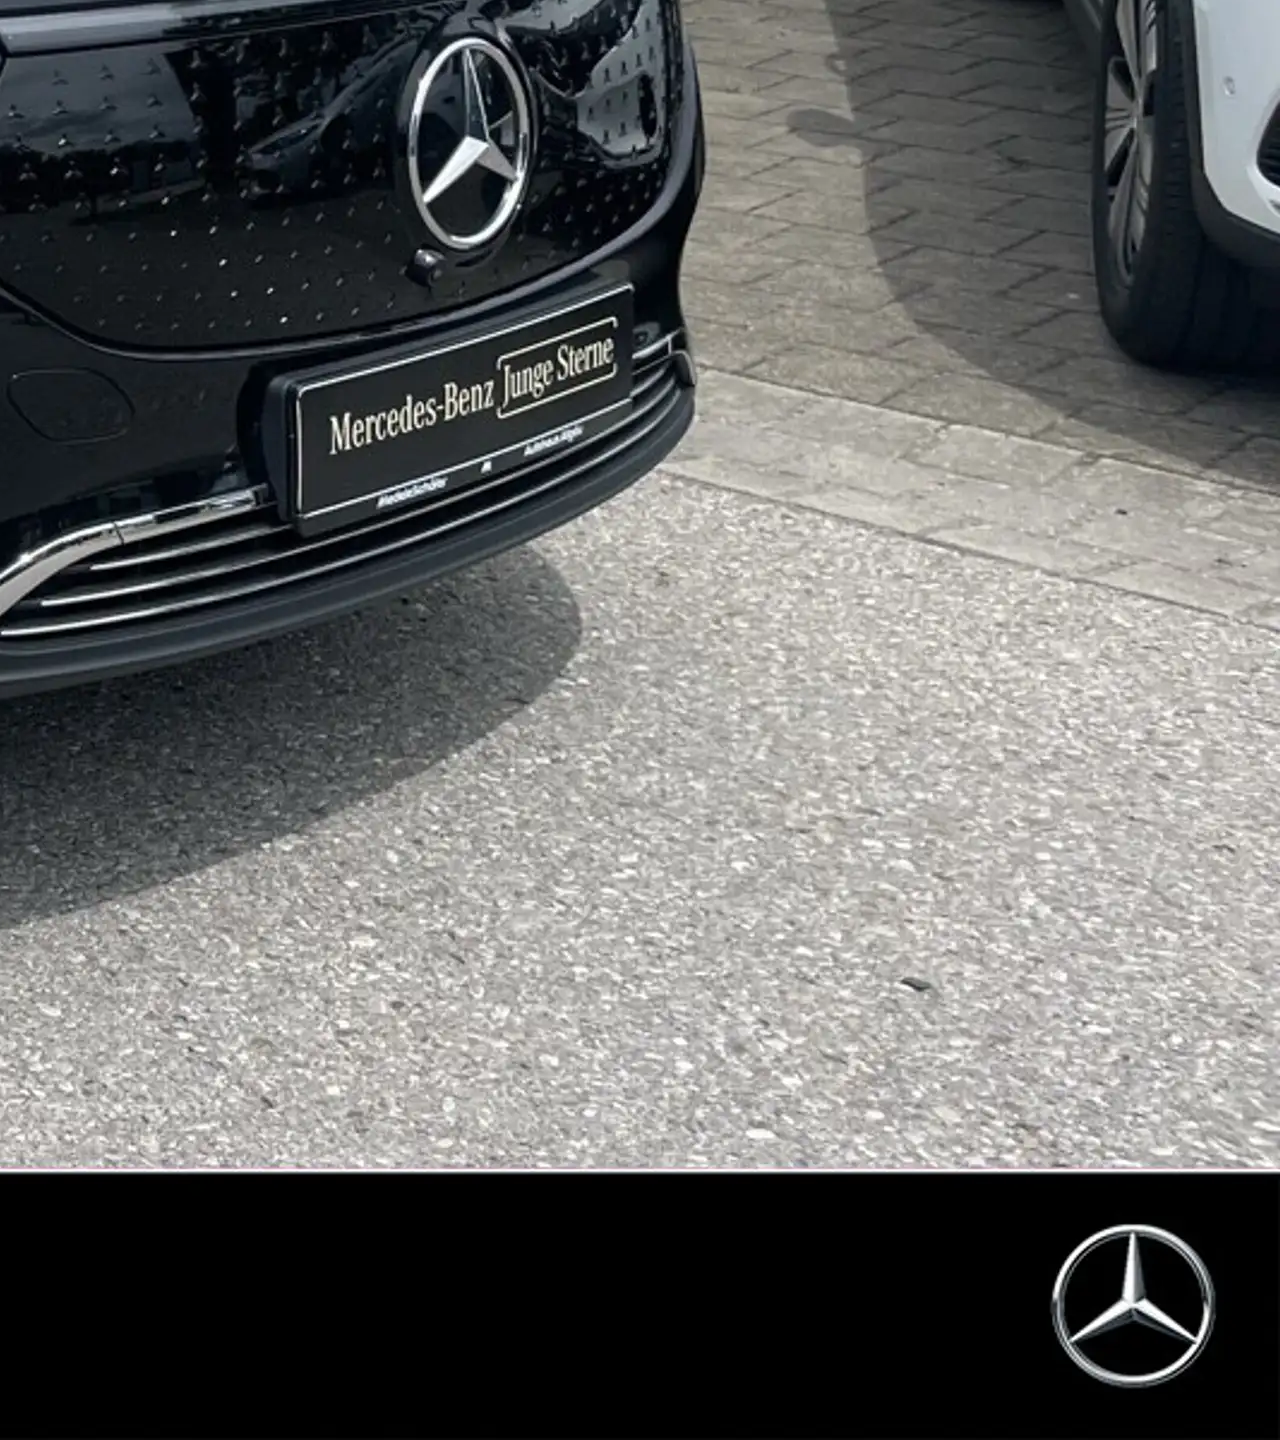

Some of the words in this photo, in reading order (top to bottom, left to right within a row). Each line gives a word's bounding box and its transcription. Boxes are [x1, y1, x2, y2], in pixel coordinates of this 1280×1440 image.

[329, 379, 495, 455] Mercedes-Benz
[502, 361, 554, 407] Junge
[557, 336, 615, 381] Sterne
